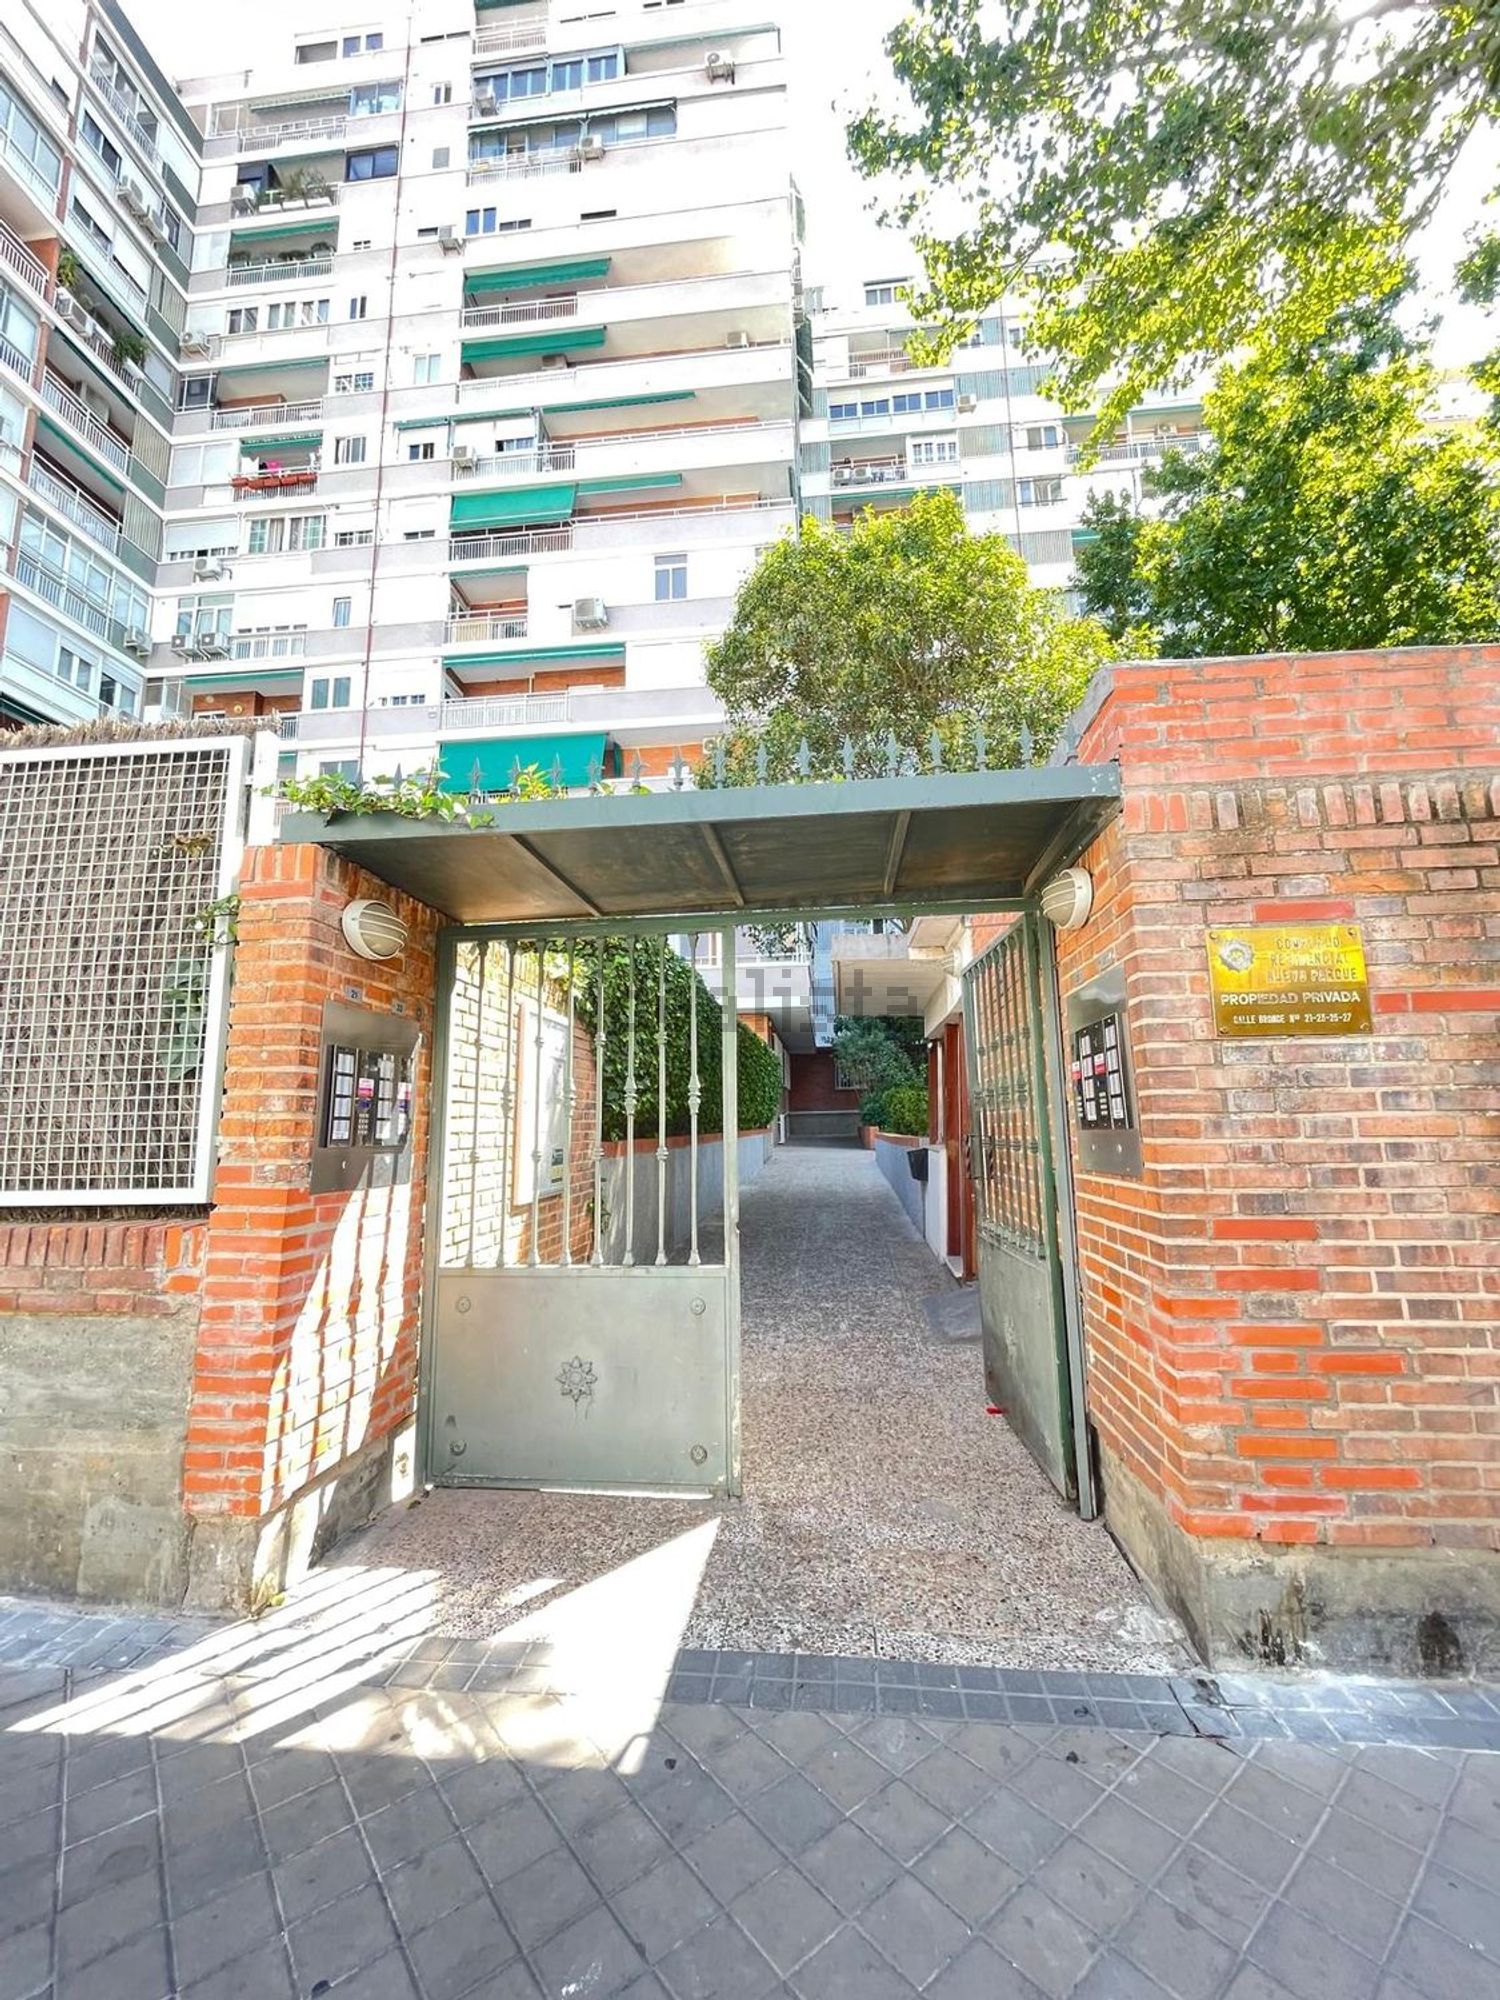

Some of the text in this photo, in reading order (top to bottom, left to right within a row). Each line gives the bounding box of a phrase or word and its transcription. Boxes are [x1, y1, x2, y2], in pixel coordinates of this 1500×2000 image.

[1310, 967, 1358, 982] PARQUE
[1221, 991, 1360, 1005] PROPIEDAD PRIVADA
[1233, 1014, 1256, 1025] CALLE
